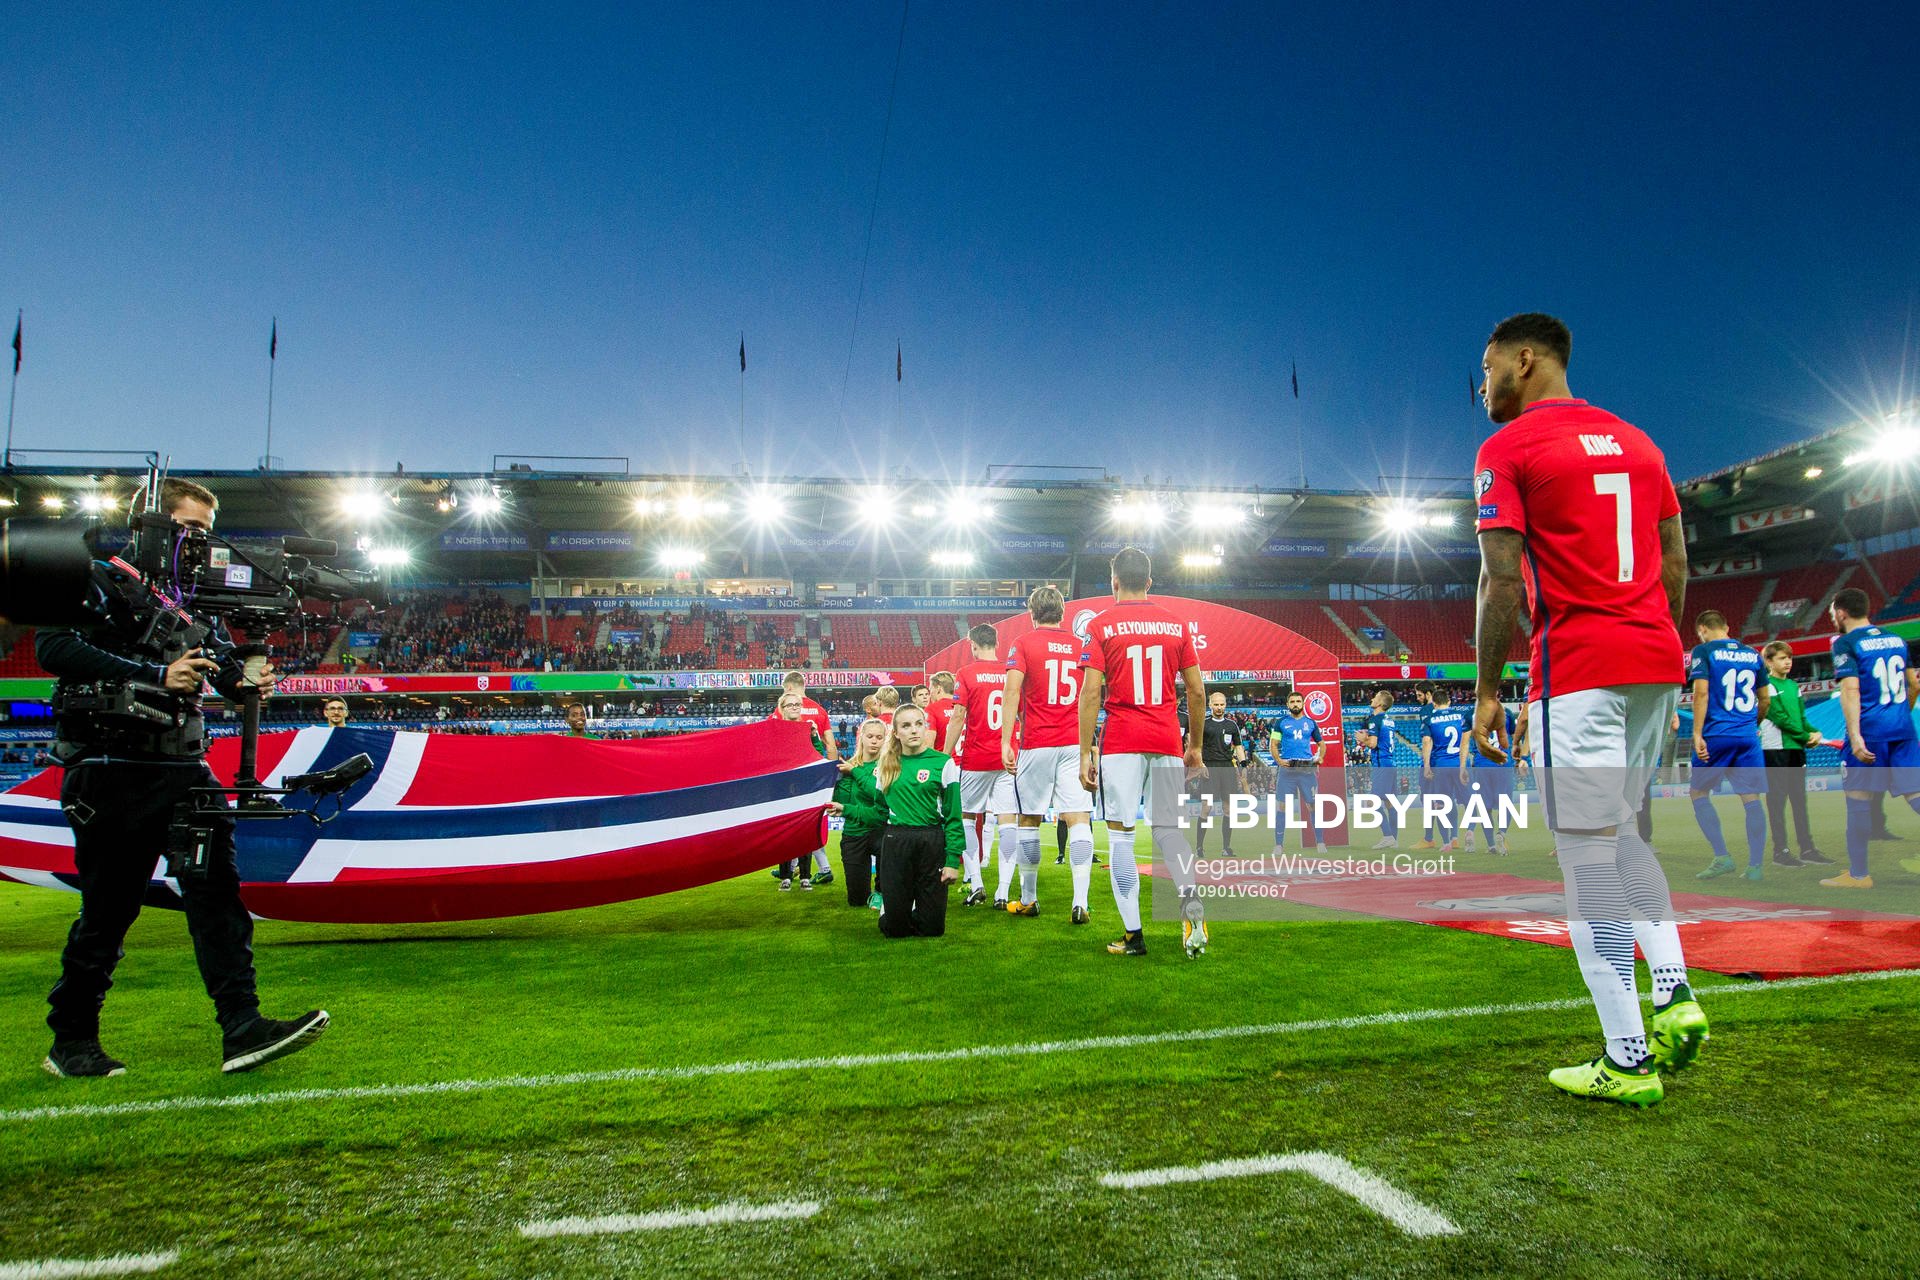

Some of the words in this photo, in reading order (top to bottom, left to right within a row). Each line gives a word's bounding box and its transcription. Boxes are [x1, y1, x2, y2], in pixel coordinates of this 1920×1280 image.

[1578, 434, 1623, 456] KING
[1479, 507, 1497, 515] PECT
[1593, 472, 1635, 583] 7
[562, 537, 595, 545] NORSK
[596, 537, 632, 545] TIPPING
[1002, 540, 1032, 548] NORSK
[1032, 540, 1064, 548] TIPPING
[1103, 625, 1117, 638] M.
[1117, 621, 1182, 638] ELYOUNOUSSI
[1048, 642, 1073, 654] BERGE
[1714, 650, 1759, 664] NAZAROV
[1045, 659, 1077, 706] 15
[1126, 645, 1163, 705] 11
[1872, 654, 1906, 705] 16
[1721, 668, 1756, 713] 13
[987, 689, 1004, 730] 6
[514, 722, 542, 730] NORSK
[596, 720, 623, 728] NORSK
[624, 720, 654, 728] TIPPING
[676, 719, 703, 727] NORSK
[1292, 729, 1303, 740] 14
[1319, 726, 1339, 736] PECT
[1444, 726, 1460, 754] 2
[1588, 1080, 1622, 1096] adidas
